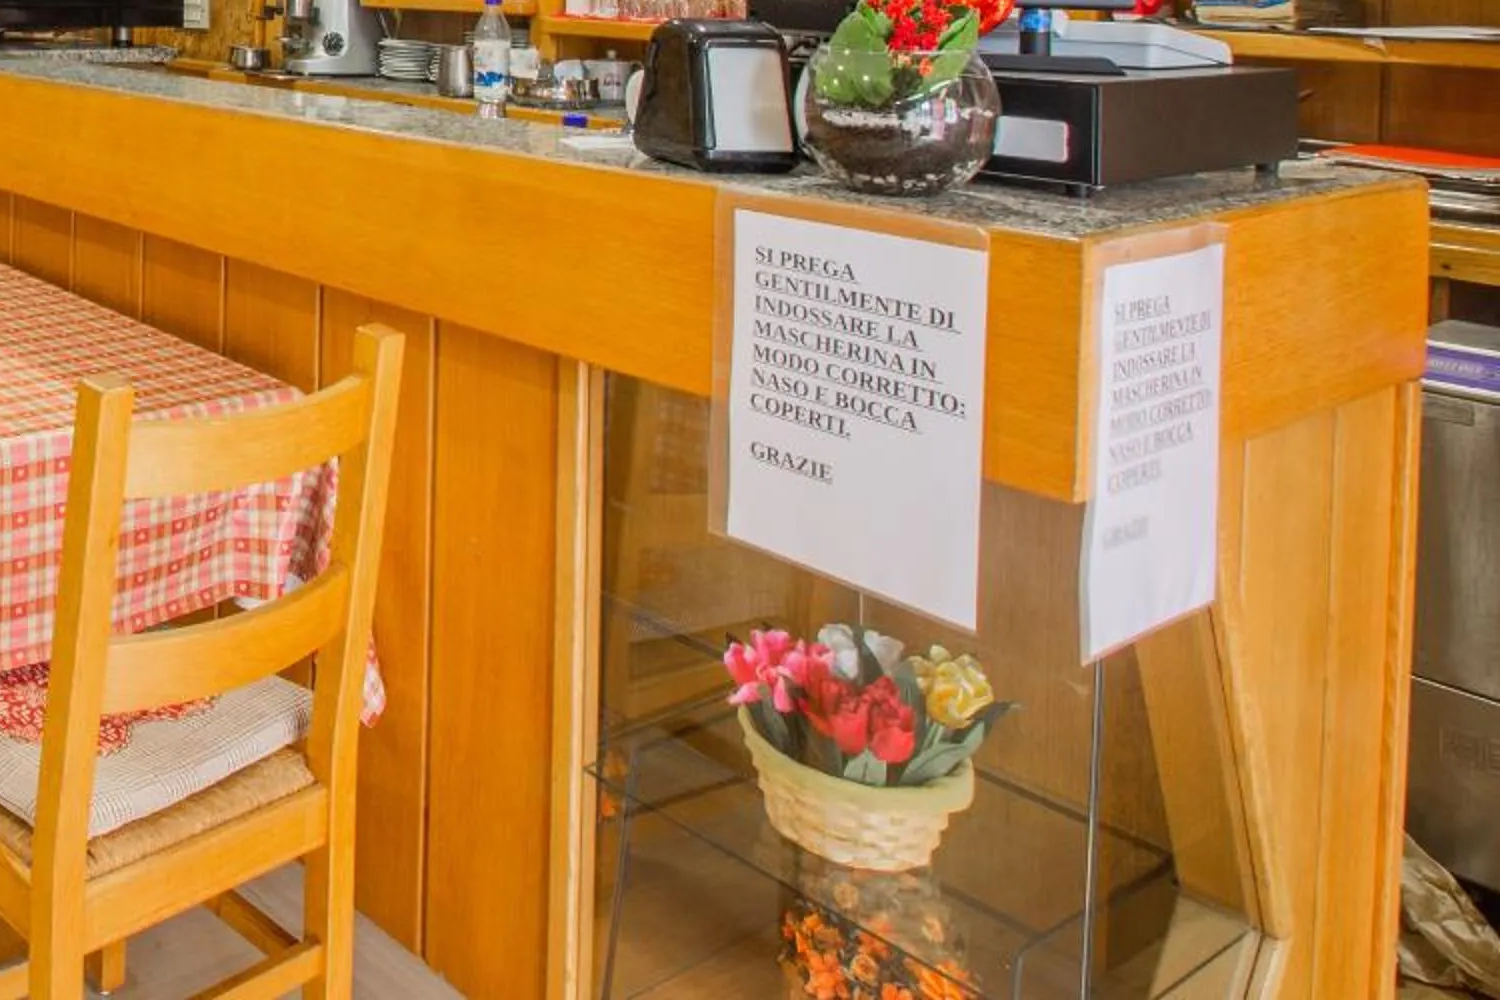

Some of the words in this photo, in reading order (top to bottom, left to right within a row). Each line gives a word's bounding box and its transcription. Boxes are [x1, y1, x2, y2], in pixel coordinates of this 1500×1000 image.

[755, 247, 773, 264] SI
[780, 251, 856, 281] PREGA
[754, 295, 879, 338] INDOSSARE
[887, 325, 920, 348] LA
[755, 270, 922, 321] GENTILMENTE
[929, 307, 956, 329] DI
[753, 319, 905, 373] MASCHERINA
[911, 358, 938, 379] IN
[753, 343, 820, 374] MODO
[752, 367, 809, 397] NASO
[815, 385, 830, 402] E
[835, 391, 918, 429] BOCCA
[750, 441, 832, 480] GRAZIE
